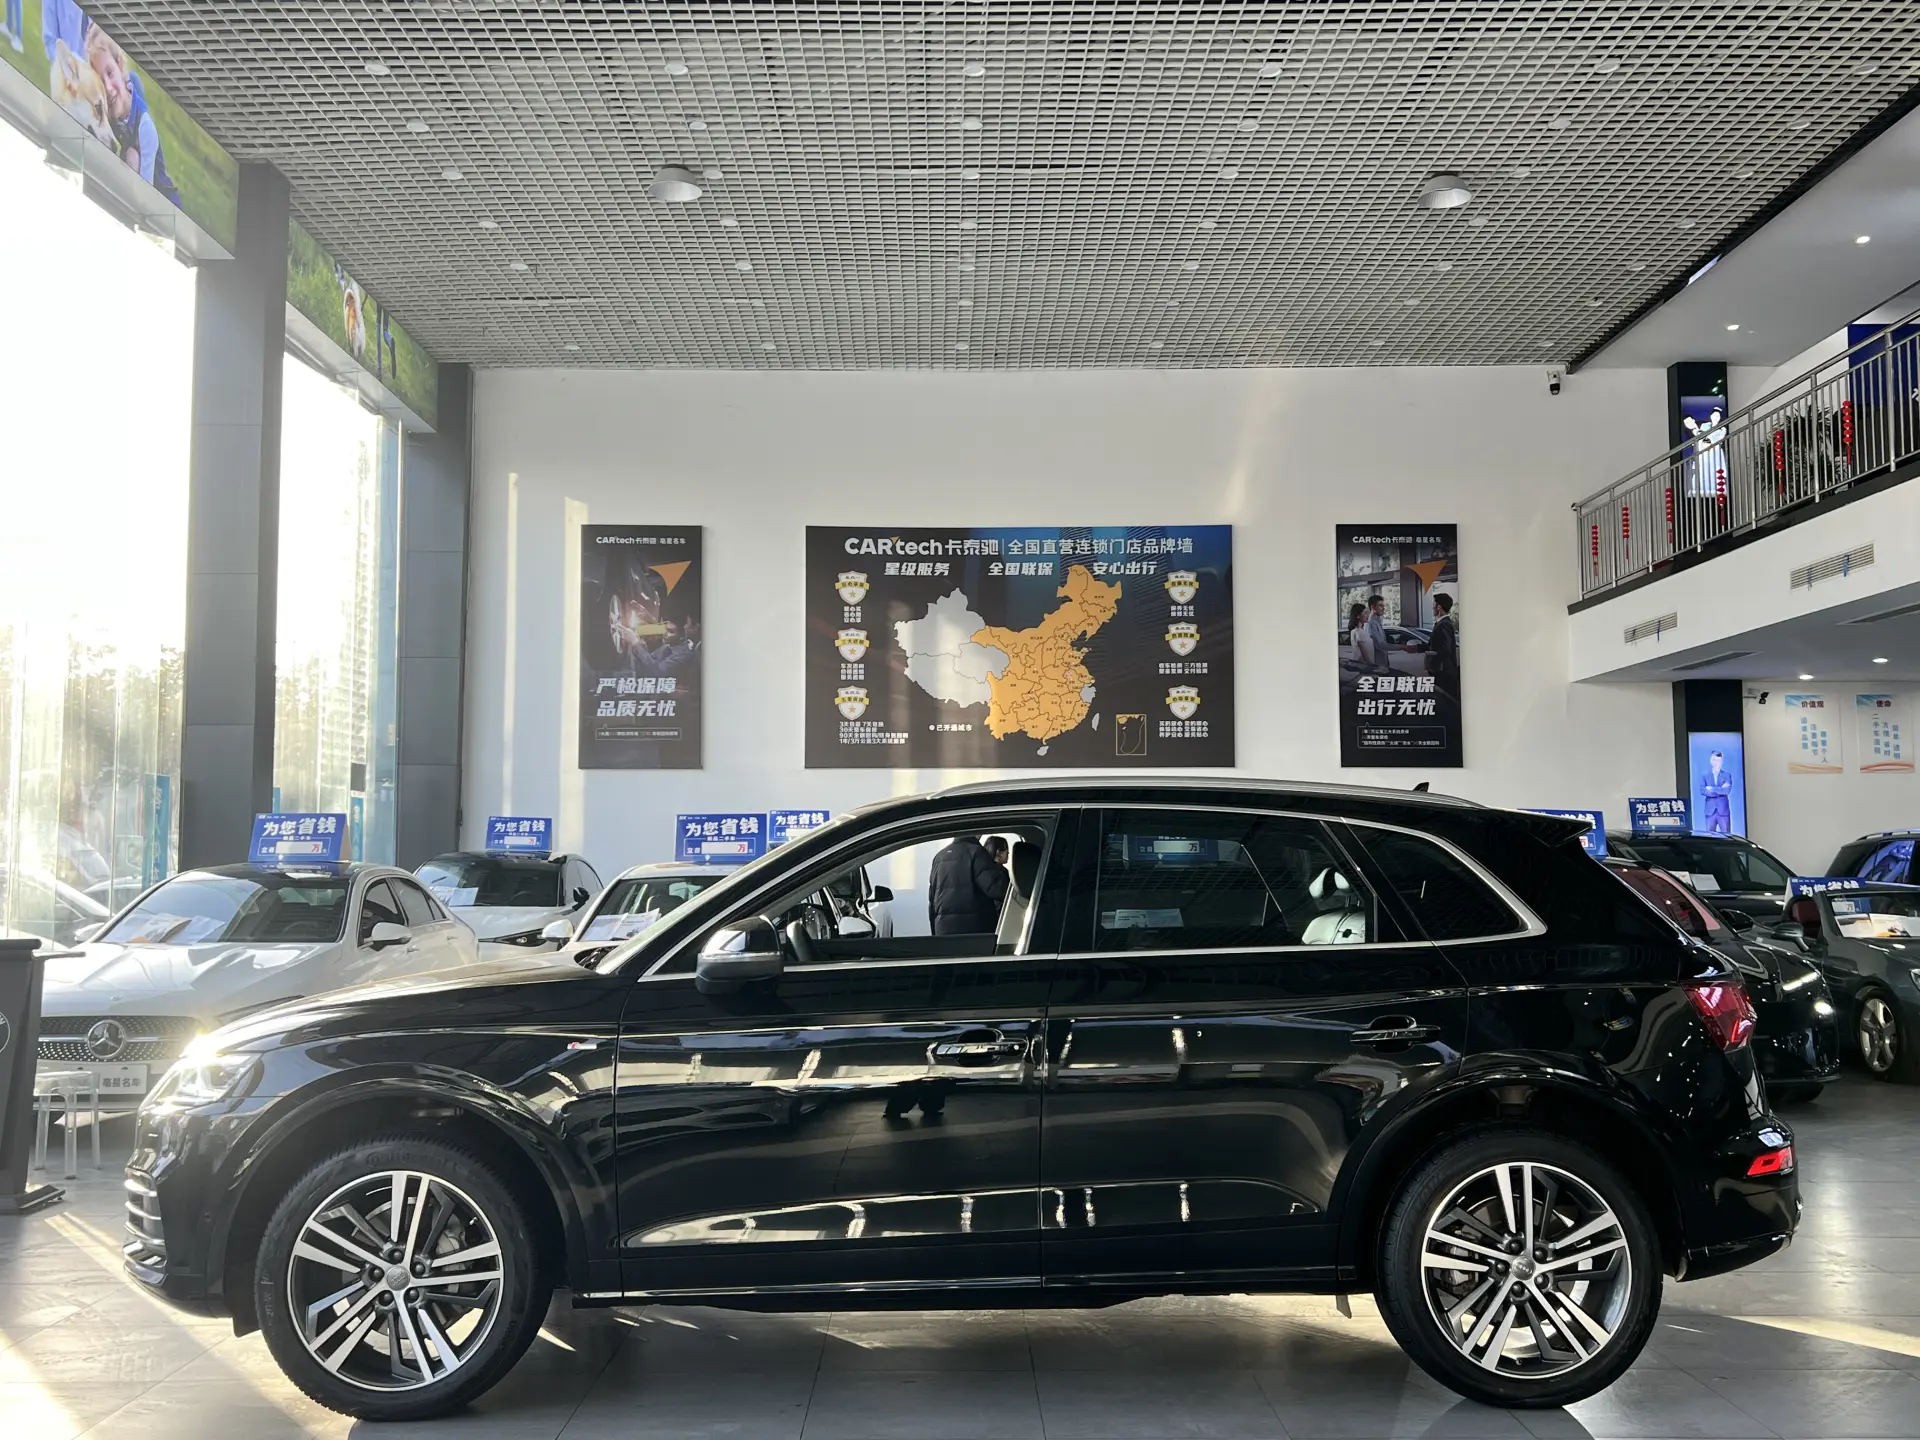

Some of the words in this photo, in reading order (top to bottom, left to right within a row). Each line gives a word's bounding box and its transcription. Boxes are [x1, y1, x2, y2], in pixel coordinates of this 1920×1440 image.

[596, 536, 635, 544] CARtech
[845, 537, 943, 555] CARtech
[945, 539, 999, 556] 卡泰驰
[1007, 537, 1194, 555] 全国直营连锁门店品牌墙
[1352, 536, 1391, 544] CARtech
[884, 562, 950, 576] 星级服务
[988, 562, 1054, 576] 全国联保
[1092, 561, 1158, 576] 安心出行
[596, 677, 676, 694] 严检保障
[1356, 676, 1435, 693] 全国联保
[596, 700, 676, 717] 品质无忧
[1357, 699, 1436, 716] 出行无忧
[1801, 700, 1825, 708] 价值观
[1876, 699, 1892, 708] 使命
[936, 723, 973, 731] 已开通城市
[1636, 800, 1685, 813] 为您省钱
[775, 812, 825, 825] 为您省钱
[262, 816, 336, 836] 为您省钱
[494, 819, 545, 833] 为您省钱
[685, 816, 758, 837] 为您省钱
[311, 843, 320, 852] 万
[737, 843, 747, 852] 万
[1188, 843, 1198, 851] 万
